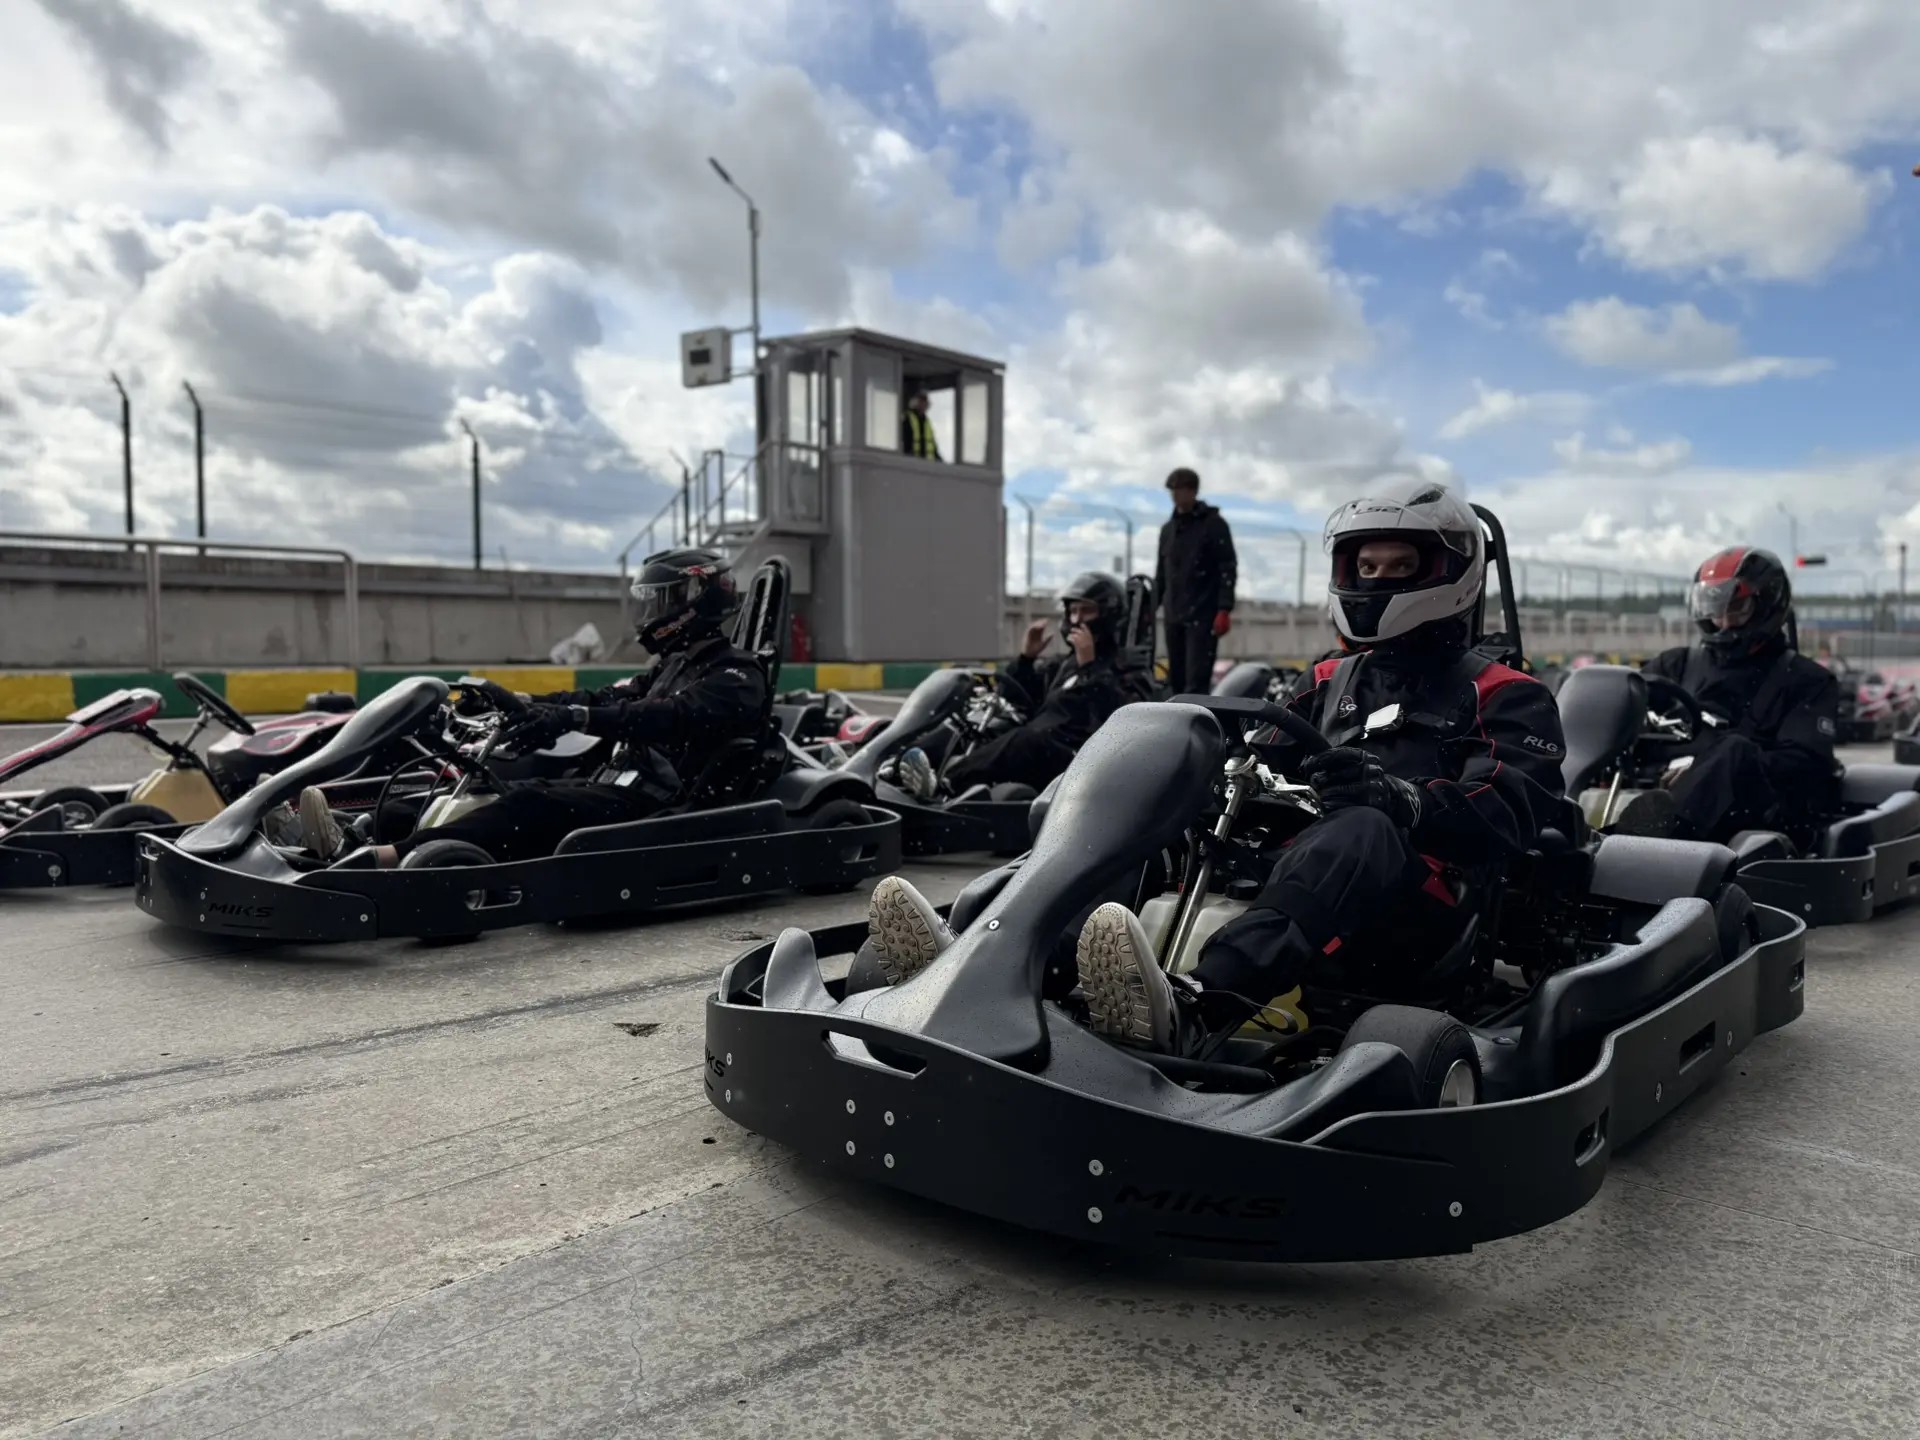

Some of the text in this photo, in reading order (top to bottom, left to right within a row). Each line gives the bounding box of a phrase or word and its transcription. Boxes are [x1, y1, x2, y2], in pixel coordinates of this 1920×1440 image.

[1523, 735, 1559, 752] RLG
[208, 902, 274, 918] MIKS
[1114, 1185, 1286, 1219] MIKS
